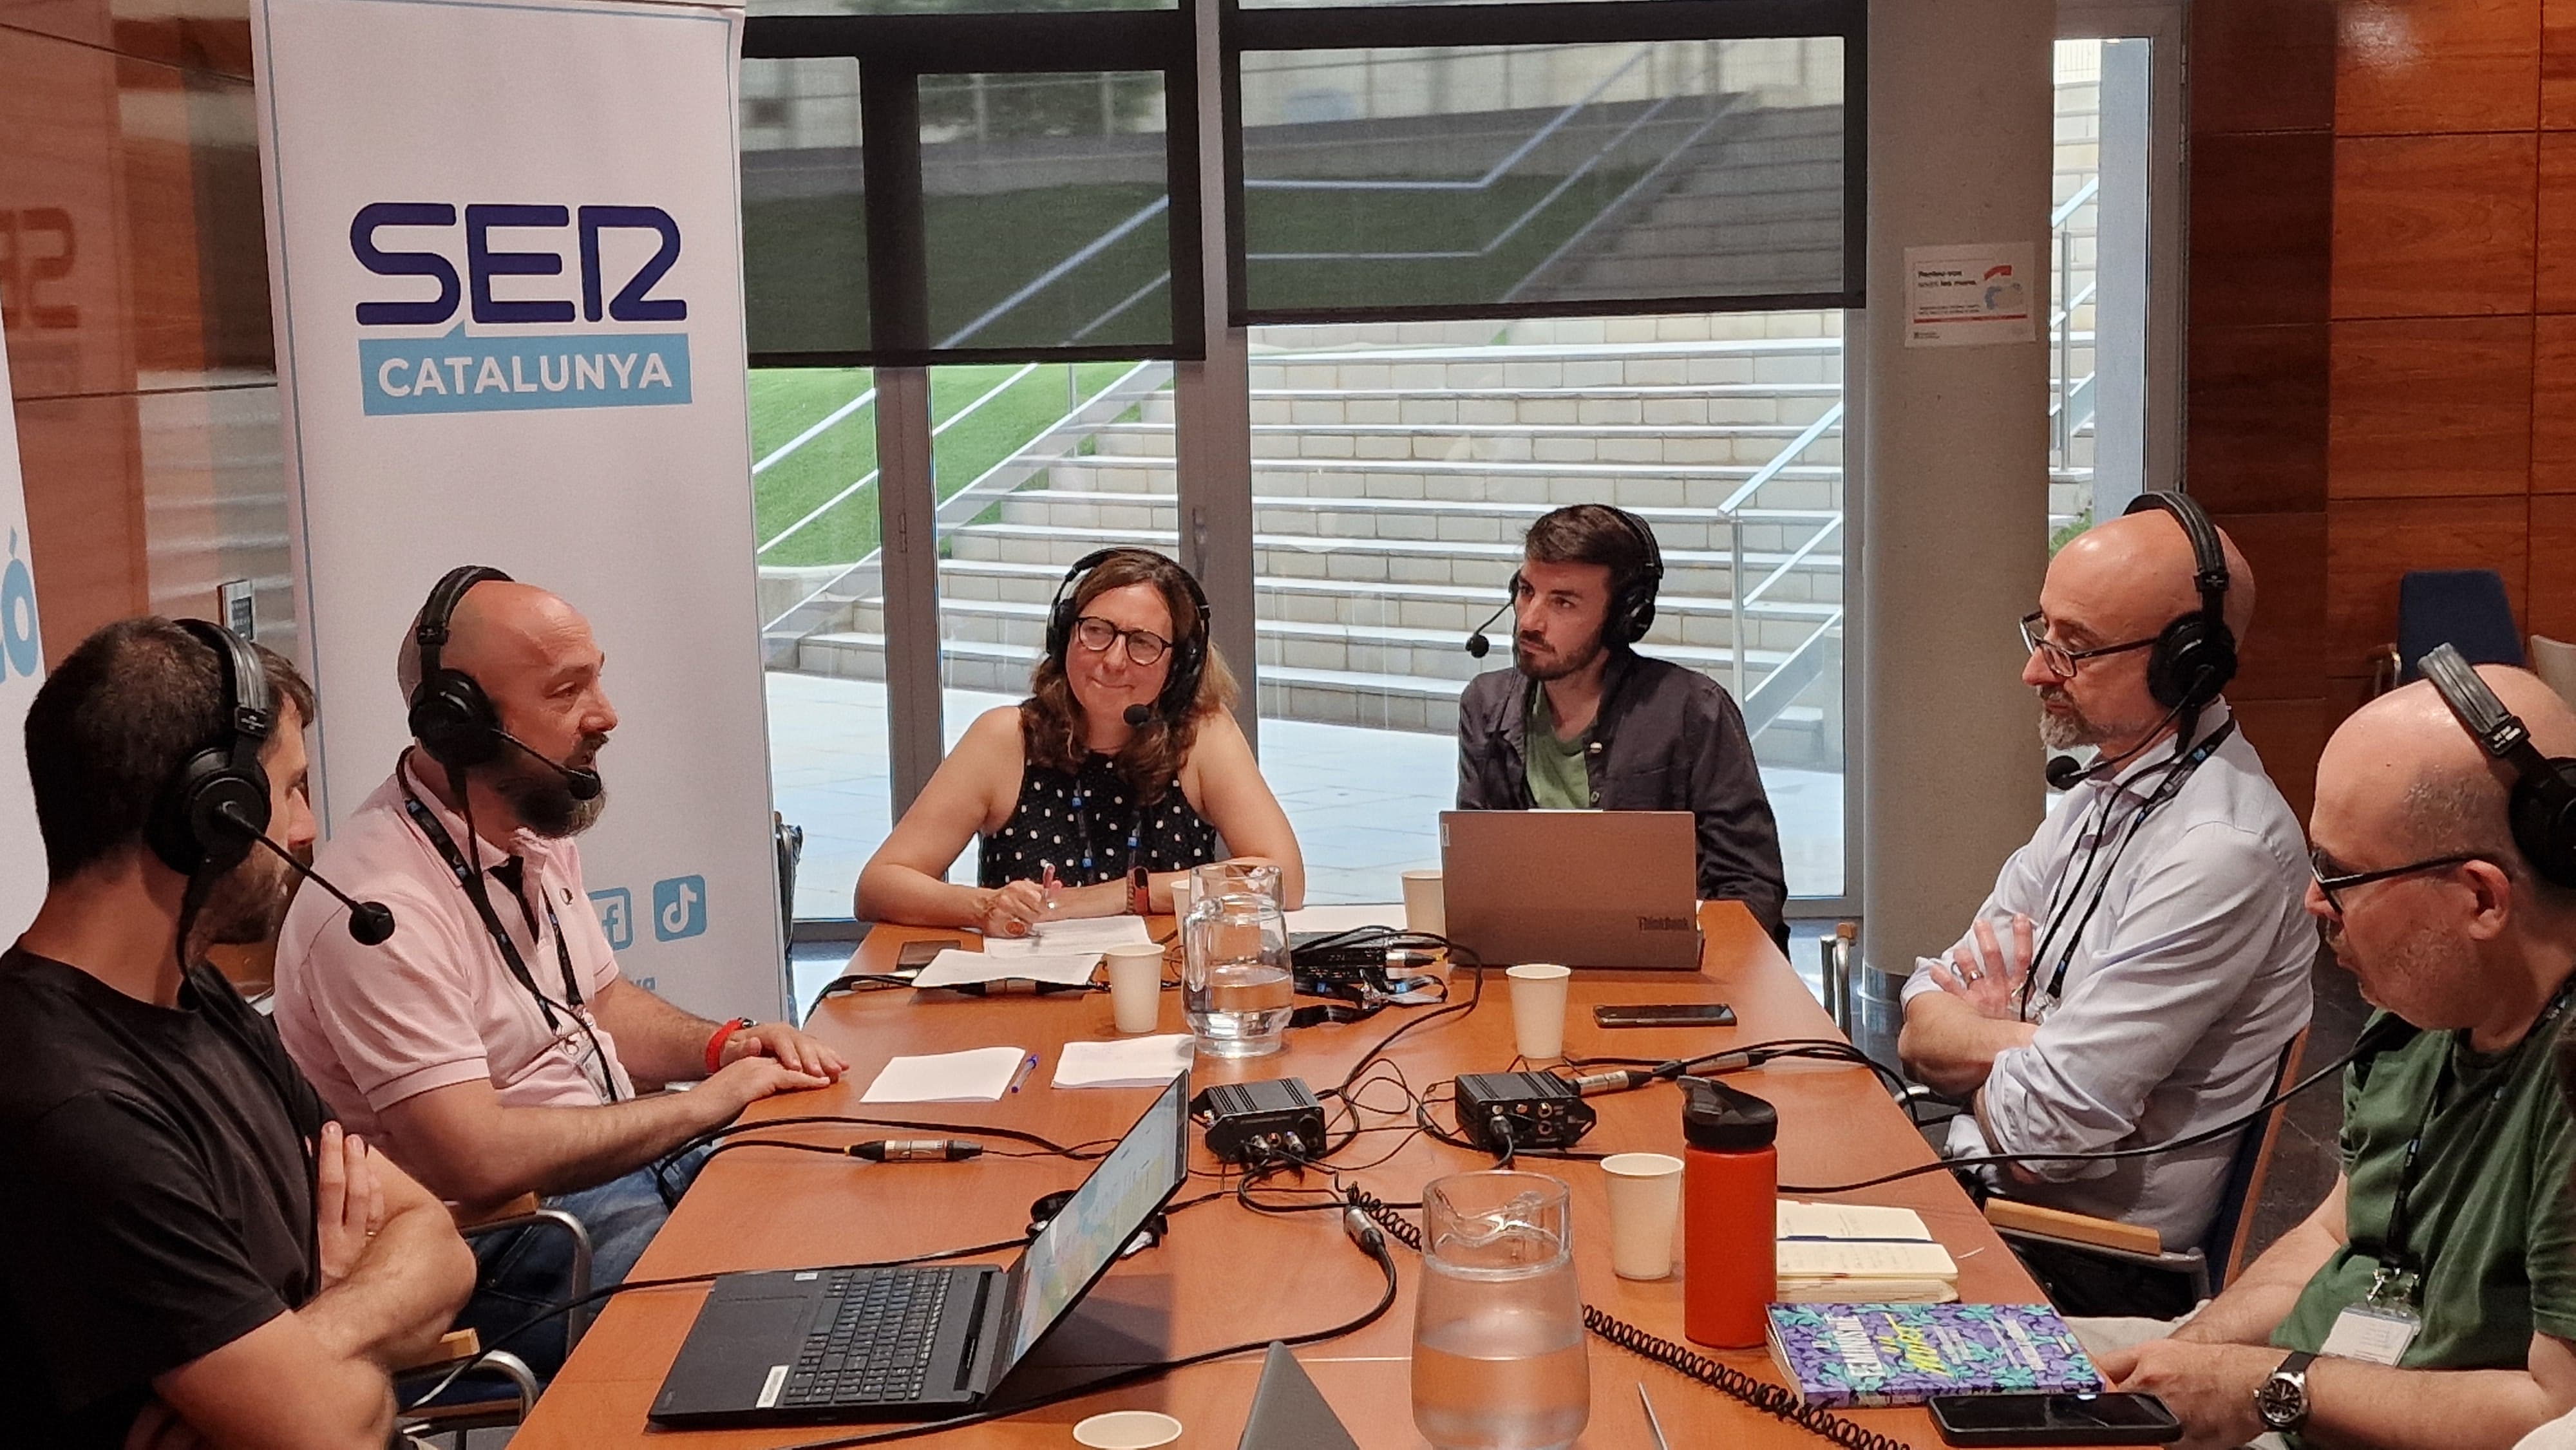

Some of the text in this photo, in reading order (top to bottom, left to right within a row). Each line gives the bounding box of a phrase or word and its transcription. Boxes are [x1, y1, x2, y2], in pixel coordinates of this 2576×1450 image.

[350, 202, 687, 325] SER
[377, 352, 673, 397] CATALUNYA
[1824, 1313, 1886, 1377] FEMINISME
